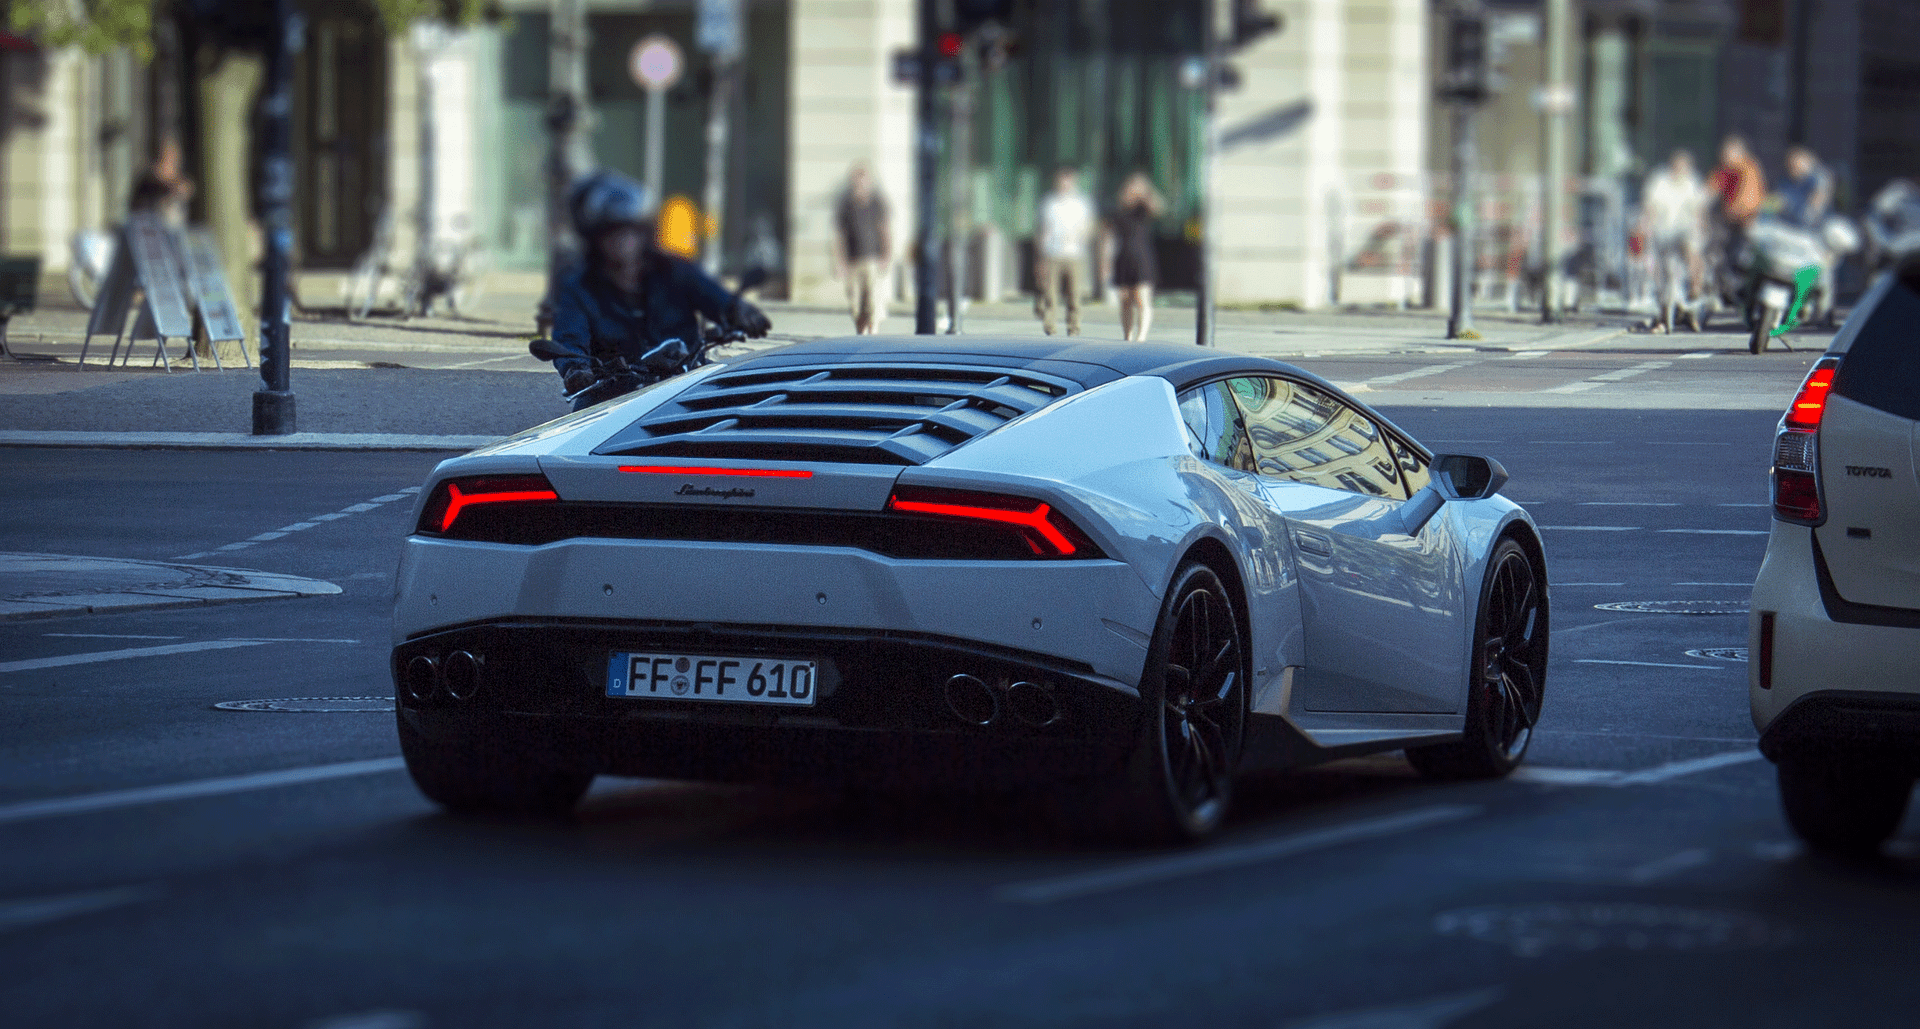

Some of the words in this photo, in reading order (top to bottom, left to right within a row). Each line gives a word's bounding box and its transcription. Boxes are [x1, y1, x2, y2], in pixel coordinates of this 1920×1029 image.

[1845, 465, 1892, 479] TOYOTA
[612, 678, 622, 689] D
[628, 656, 673, 692] FF
[694, 660, 740, 695] FF
[746, 662, 811, 699] 610
